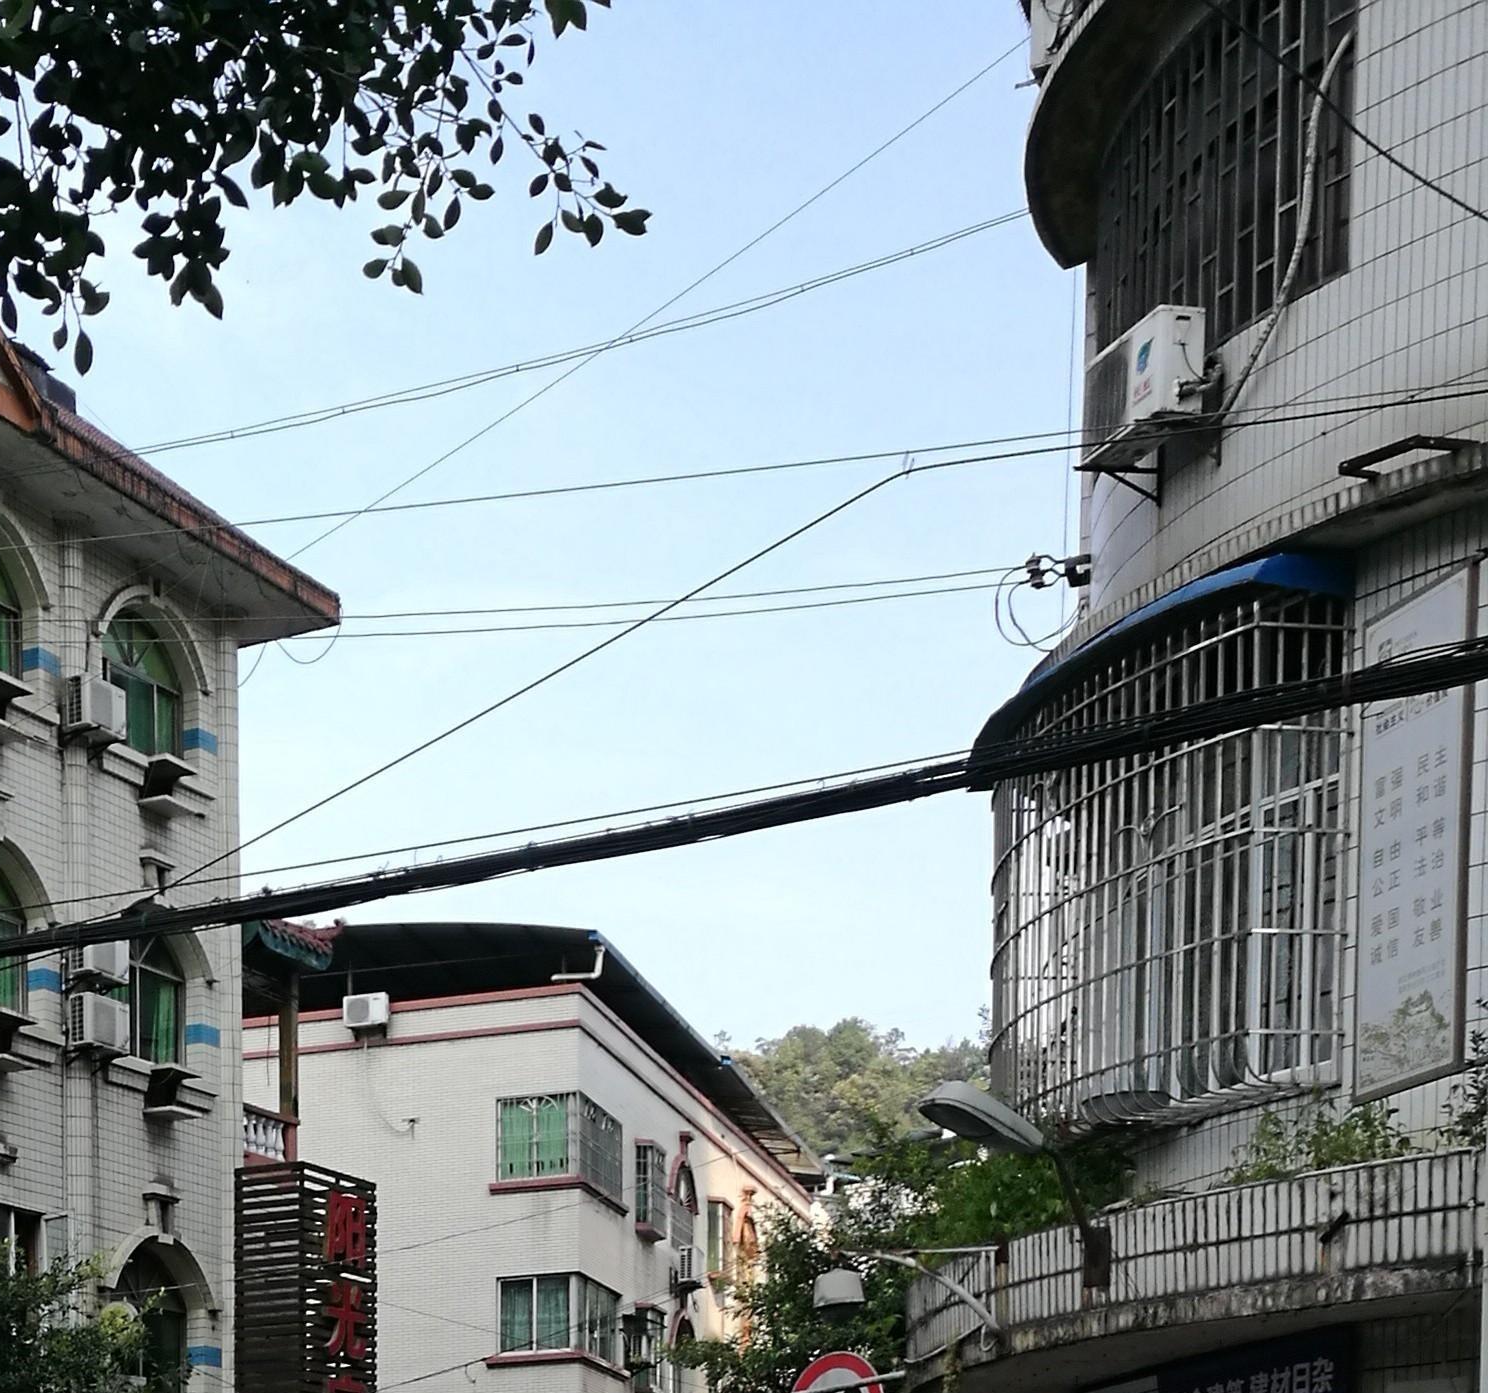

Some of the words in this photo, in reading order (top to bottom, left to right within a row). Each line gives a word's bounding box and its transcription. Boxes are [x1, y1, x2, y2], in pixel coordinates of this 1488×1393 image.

[1416, 745, 1448, 777] 民主
[1374, 797, 1402, 830] 文明
[1373, 840, 1401, 869] 自由
[1415, 816, 1446, 847] 平等
[1372, 869, 1401, 898] 公正
[1414, 848, 1444, 878] 法治
[1371, 906, 1400, 938] 爱国
[1413, 888, 1443, 918] 敬业
[1370, 938, 1399, 966] 诚信
[1414, 917, 1442, 948] 友善
